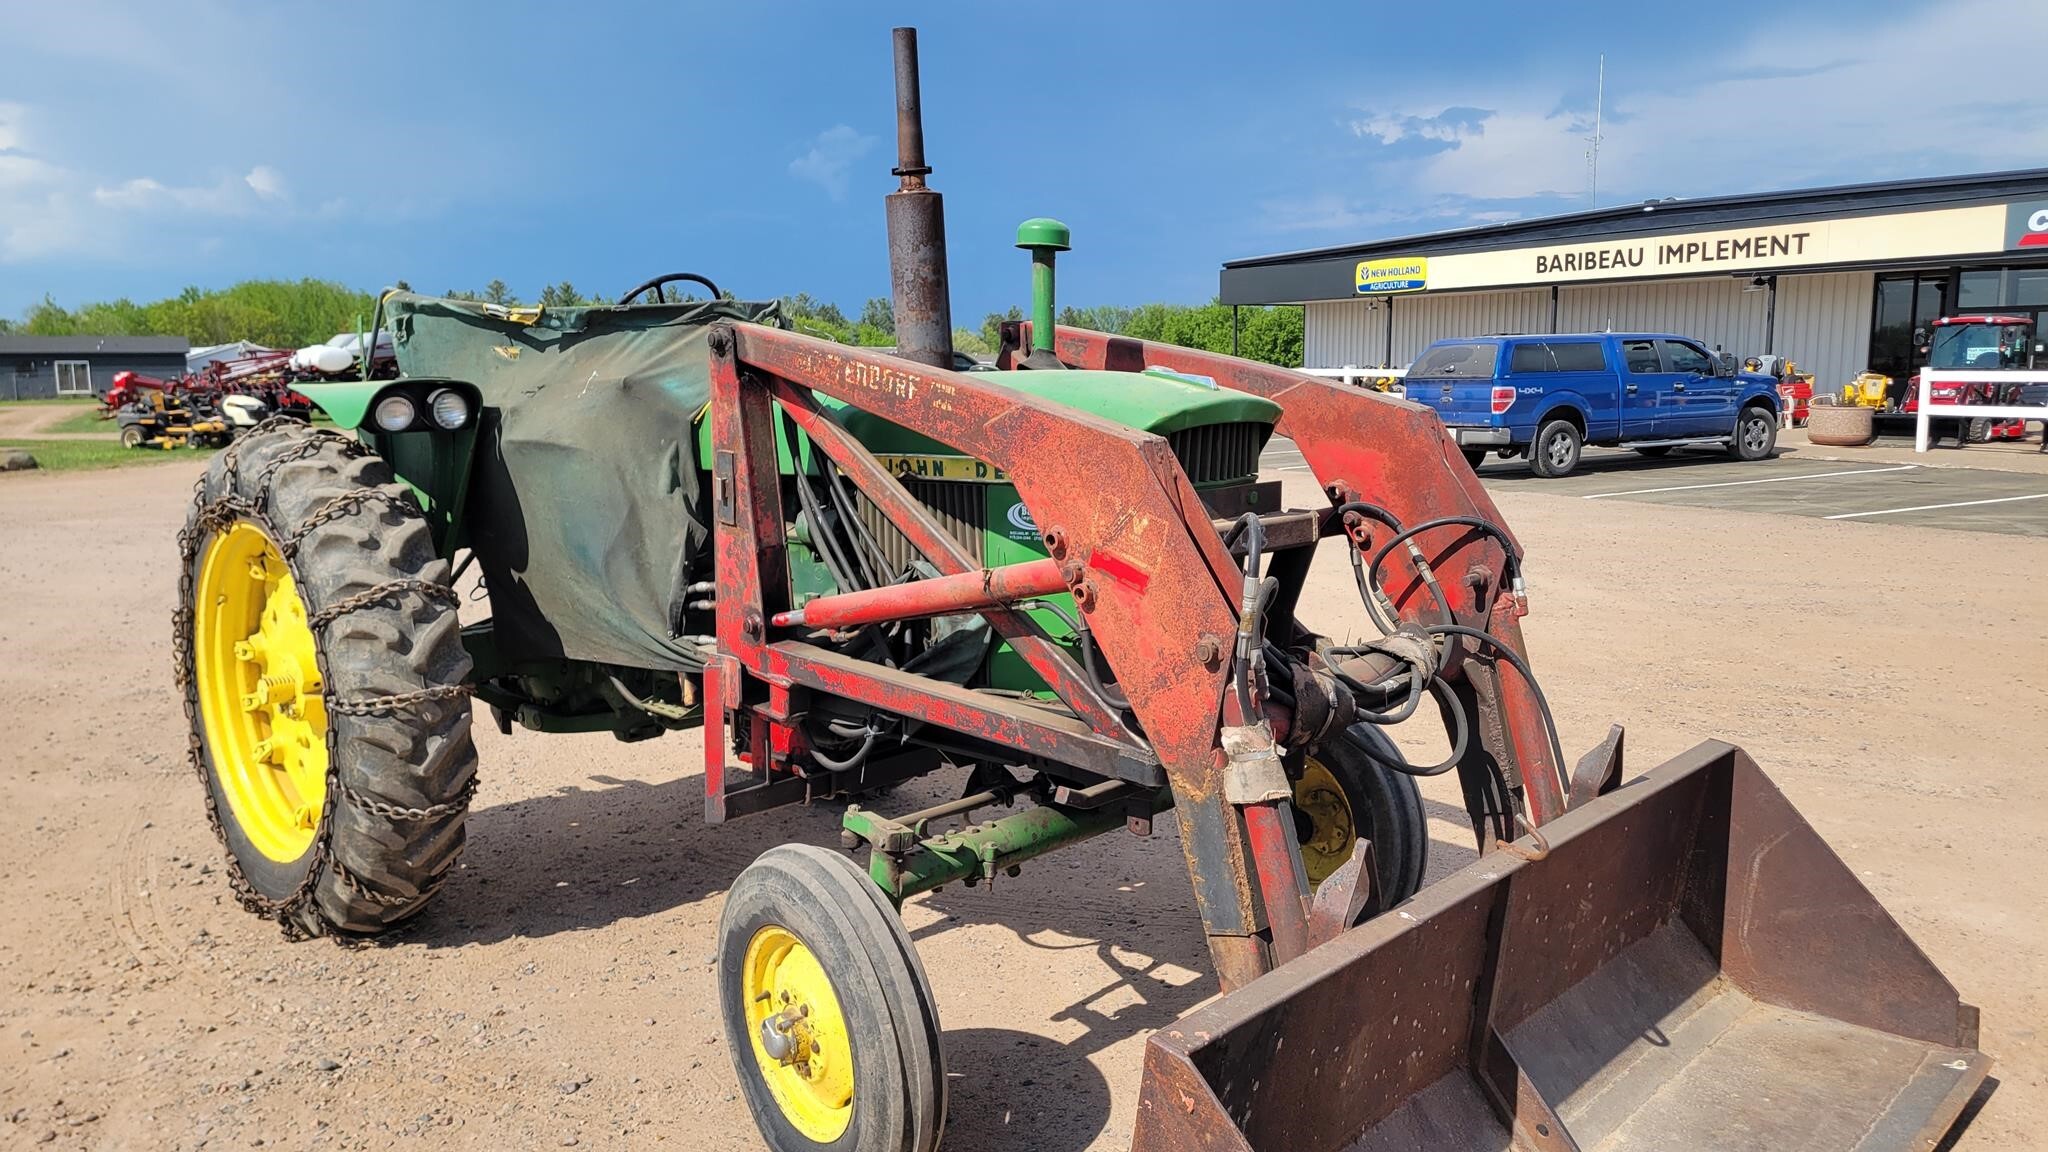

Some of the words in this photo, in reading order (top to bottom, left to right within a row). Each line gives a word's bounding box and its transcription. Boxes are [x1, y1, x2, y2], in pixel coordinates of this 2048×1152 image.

[1536, 247, 1644, 273] BARIBEAU
[1658, 233, 1810, 265] IMPLEMENT
[1371, 268, 1387, 278] NEW
[1388, 265, 1421, 277] HOLLAND
[1370, 280, 1409, 290] AGRICULTURE
[885, 458, 944, 477] JOHN
